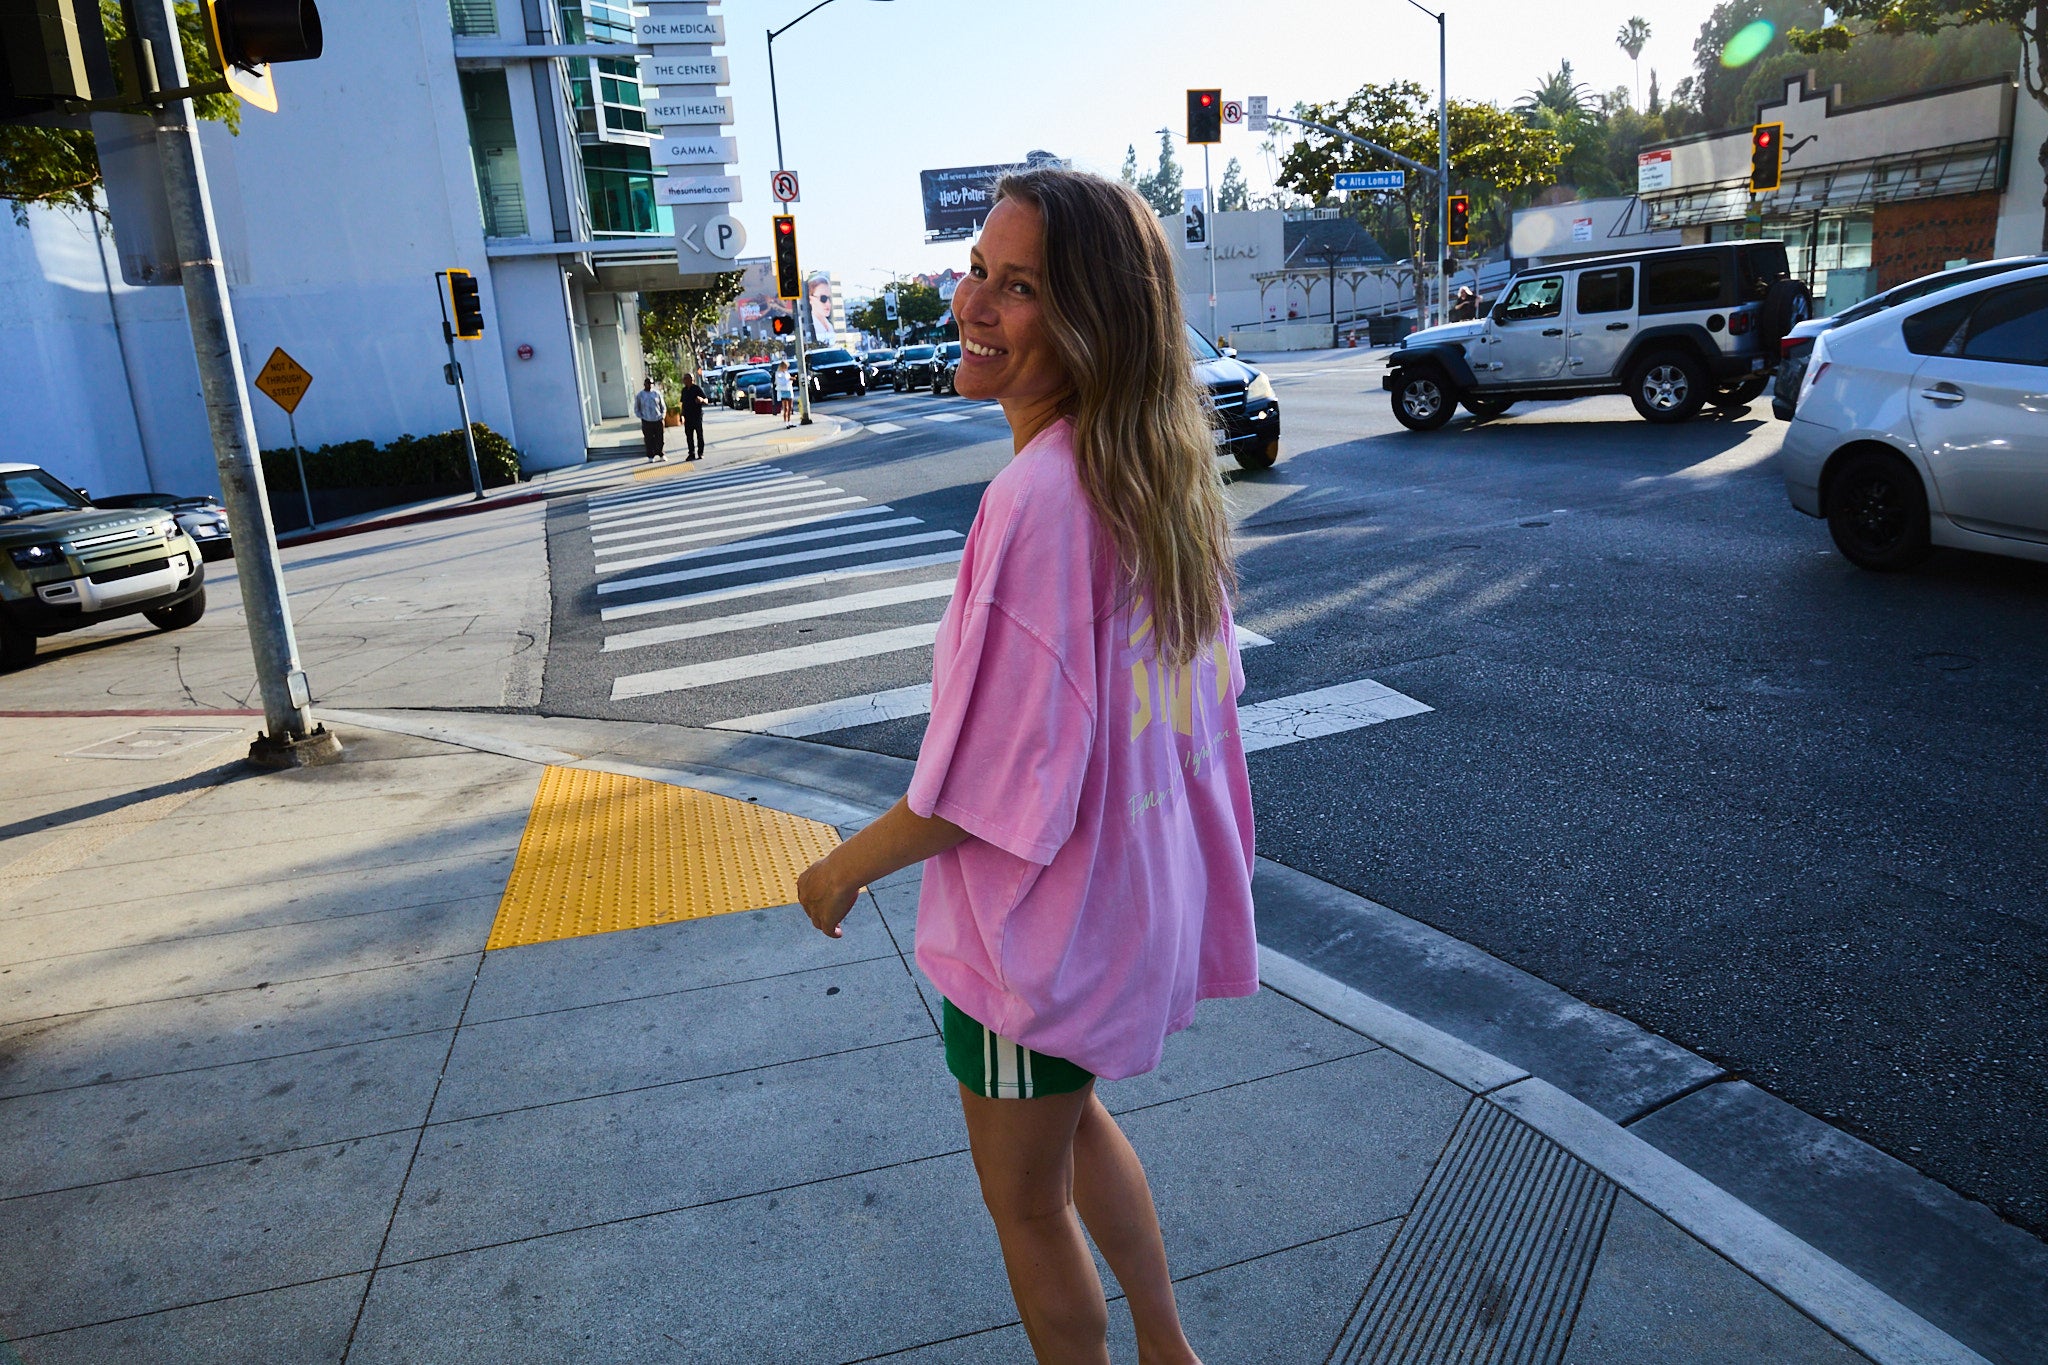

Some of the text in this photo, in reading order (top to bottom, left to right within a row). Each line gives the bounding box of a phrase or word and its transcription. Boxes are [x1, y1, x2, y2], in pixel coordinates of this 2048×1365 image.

[642, 24, 716, 34] ONE MEDICAL
[655, 65, 716, 75] THE CENTER
[671, 146, 718, 155] GAMMA.
[938, 172, 949, 180] All
[1350, 175, 1400, 186] Alta Loma Rd
[668, 185, 730, 195] thesunsetla.com
[940, 187, 986, 207] Harry Potter
[717, 224, 732, 250] P
[270, 361, 294, 371] NOT A
[266, 374, 303, 384] THROUGH
[272, 386, 300, 397] STREET
[67, 516, 147, 535] DEFENDER
